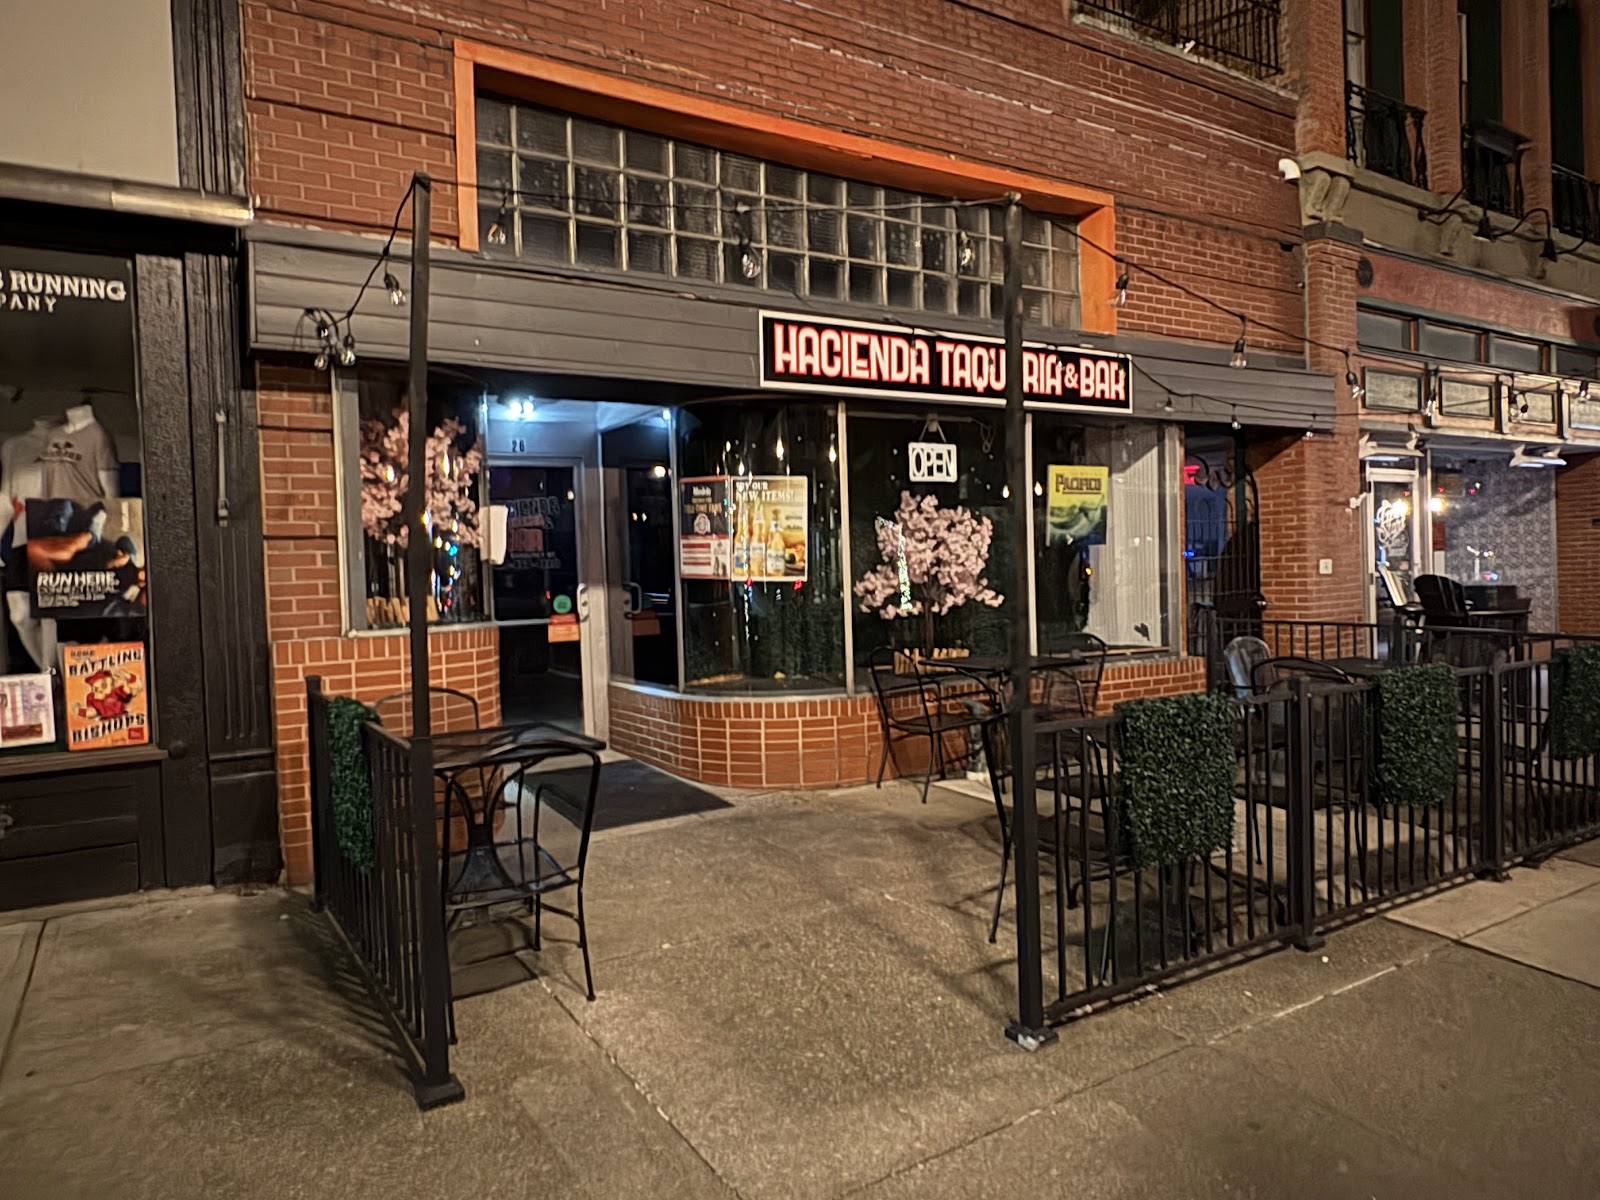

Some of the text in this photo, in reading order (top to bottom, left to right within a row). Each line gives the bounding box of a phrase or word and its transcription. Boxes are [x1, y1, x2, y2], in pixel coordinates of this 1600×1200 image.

[9, 269, 127, 302] RUNNING
[773, 323, 1126, 401] HACIENDA TAQURIA & BAR
[911, 447, 953, 478] OPEN
[37, 571, 73, 587] RUN
[68, 648, 142, 676] BATTLING
[72, 713, 145, 743] BISHOPS
